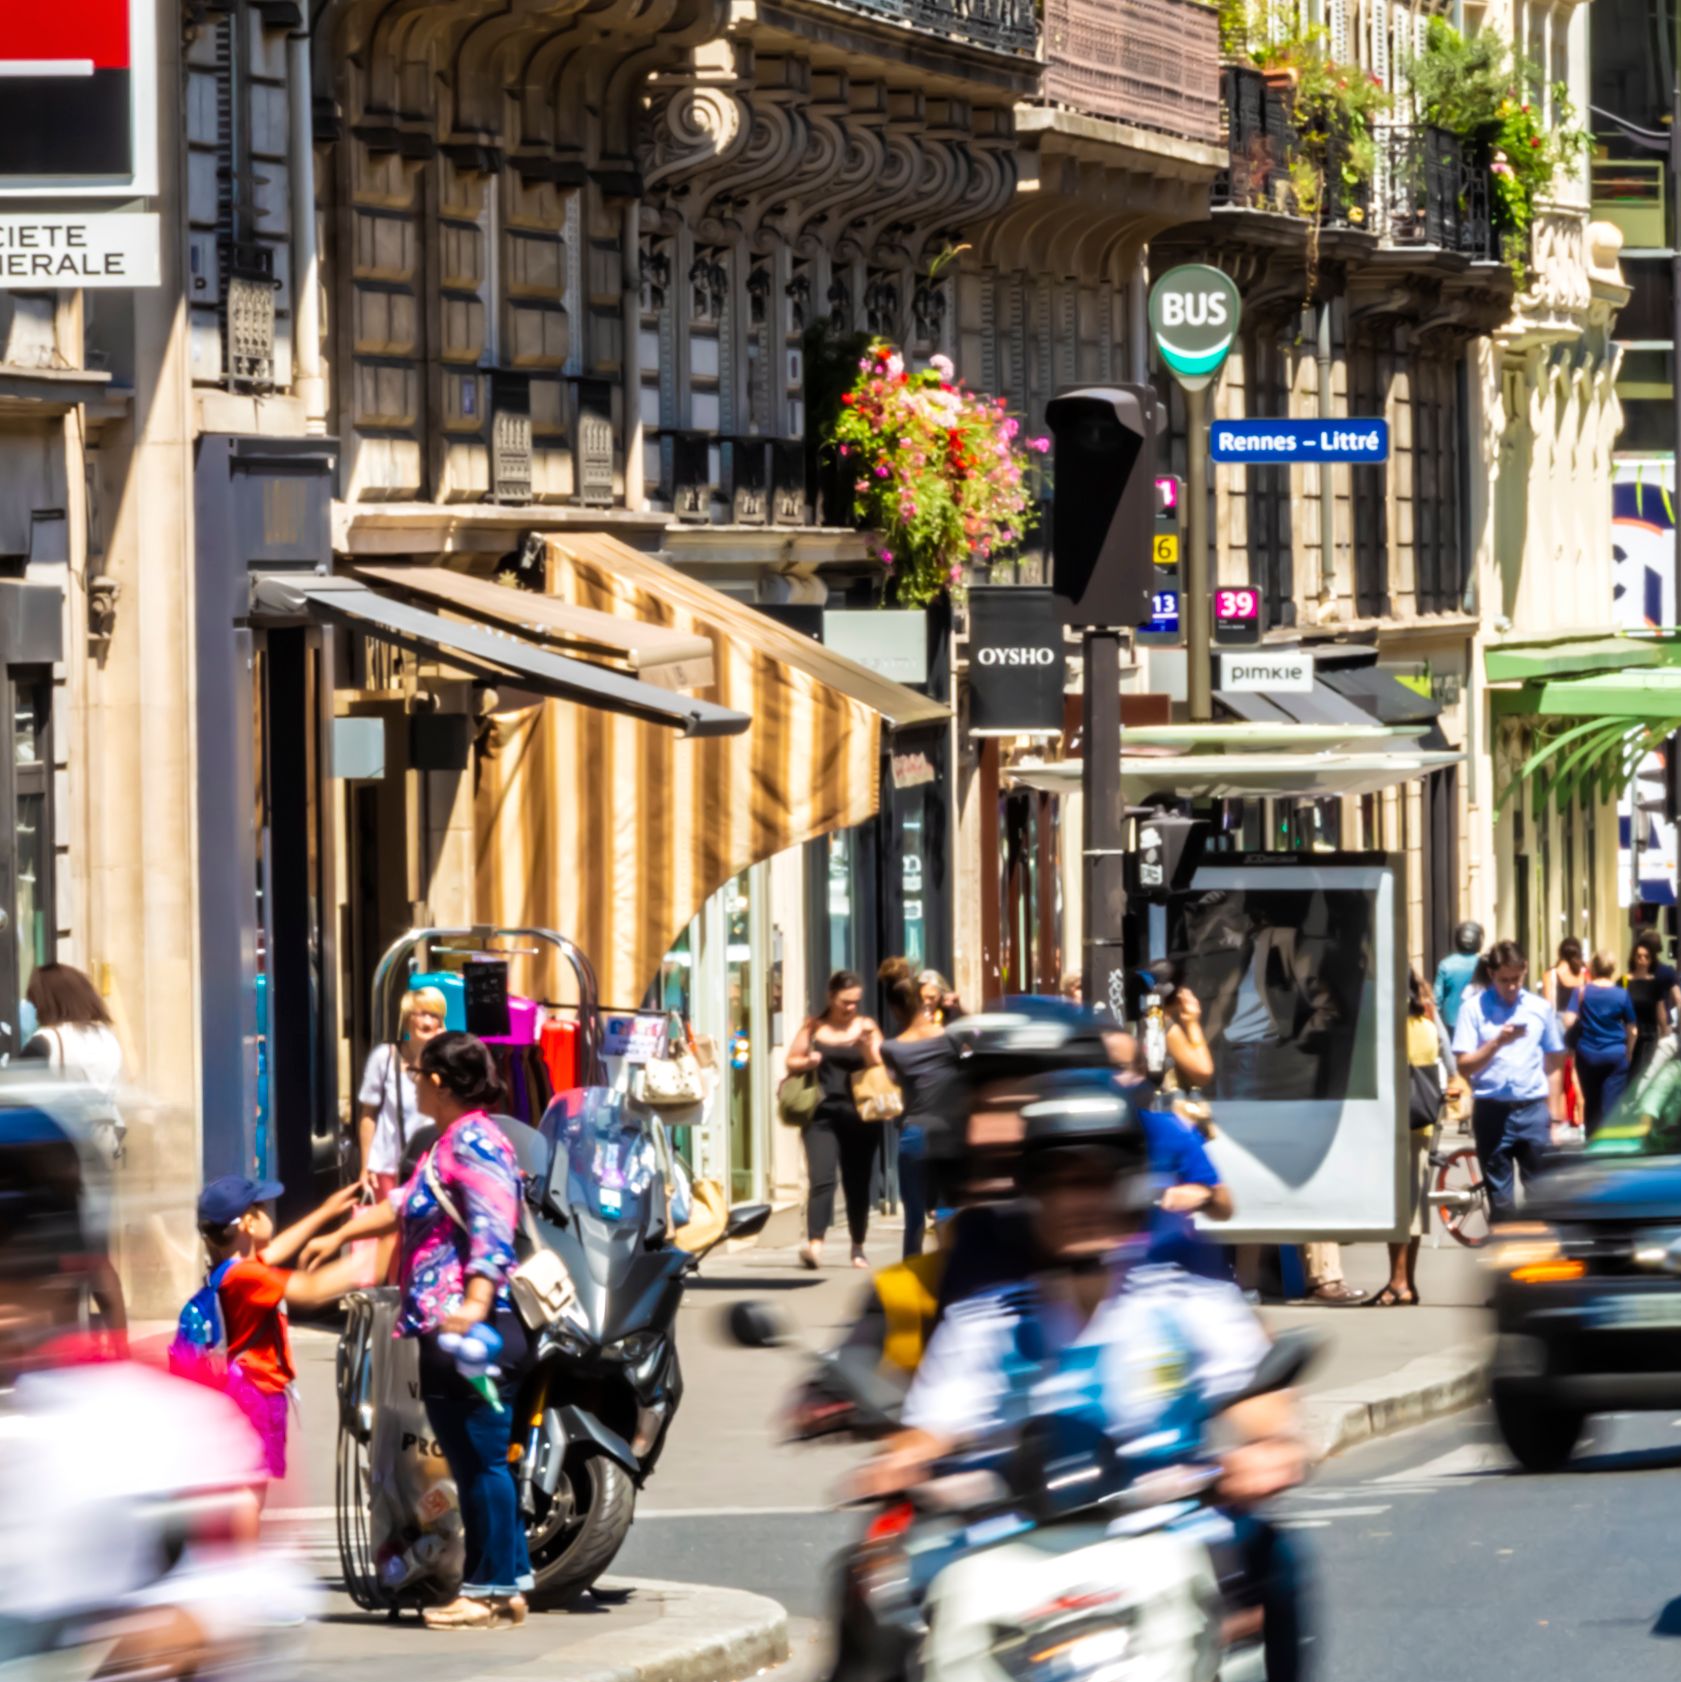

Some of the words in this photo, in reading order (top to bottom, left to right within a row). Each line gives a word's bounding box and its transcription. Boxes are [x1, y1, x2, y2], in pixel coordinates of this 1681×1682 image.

[0, 226, 87, 247] IETE
[0, 253, 125, 275] ERALE
[1162, 292, 1227, 326] BUS
[1219, 432, 1297, 451] Rennes
[1320, 431, 1379, 451] Littré
[1221, 592, 1253, 616] 39
[977, 648, 1055, 666] OYSHO
[1231, 665, 1303, 683] pimkie
